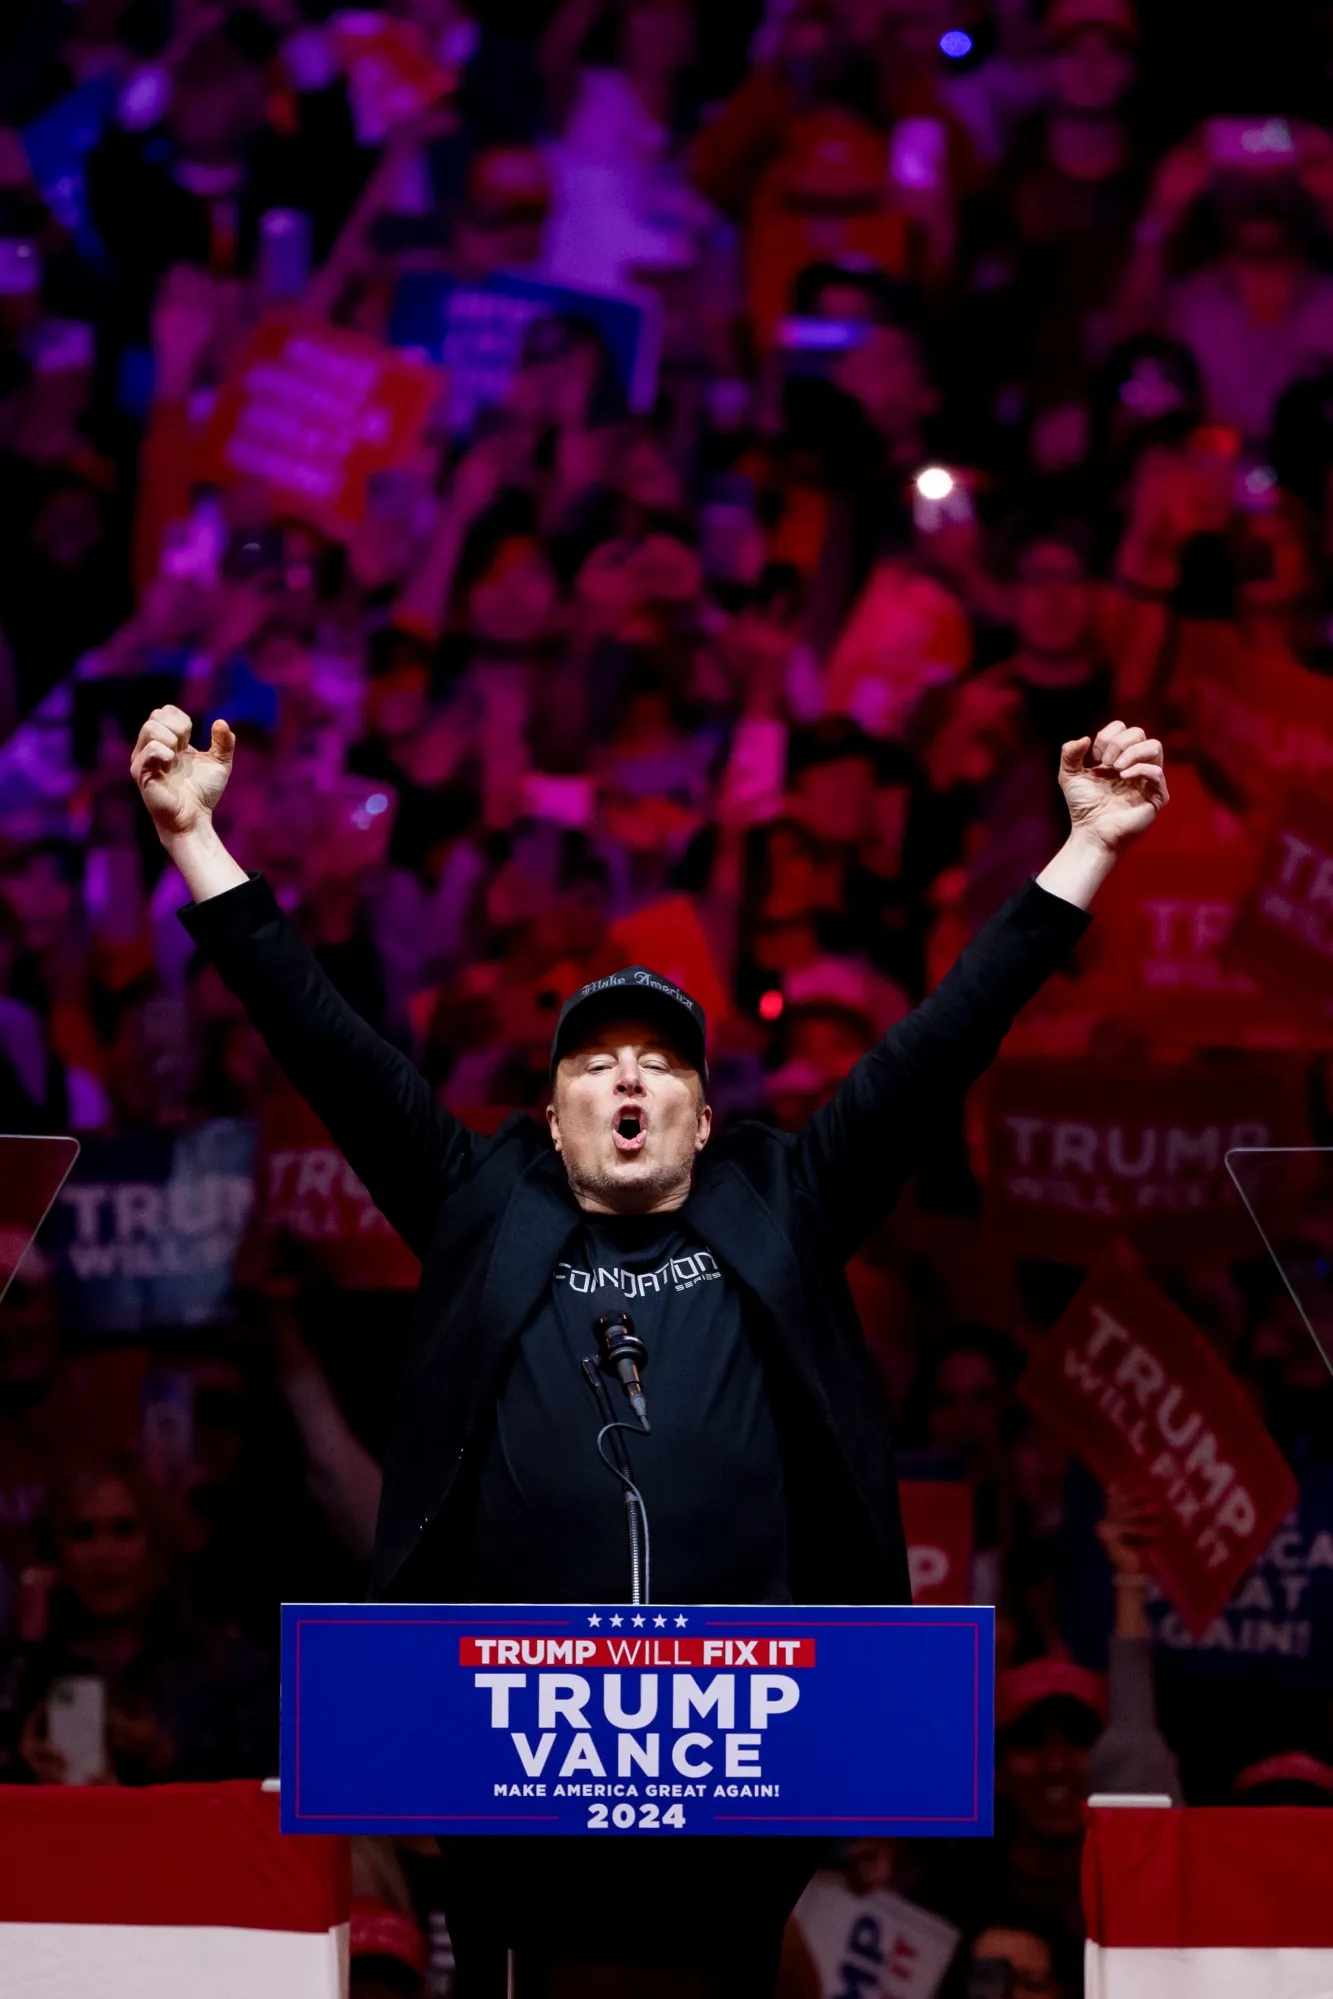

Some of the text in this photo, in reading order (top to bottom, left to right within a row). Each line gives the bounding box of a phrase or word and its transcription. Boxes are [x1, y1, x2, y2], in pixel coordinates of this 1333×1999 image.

[580, 971, 694, 1011] Make America
[1084, 1303, 1257, 1538] TRUMP
[475, 1639, 801, 1666] TRUMP WILL FIX IT
[1158, 1611, 1314, 1660] GAIN!
[474, 1673, 801, 1730] TRUMP
[510, 1732, 762, 1779] VANCE
[494, 1783, 780, 1798] MAKE AMERICA GREAT AGAIN!
[587, 1803, 686, 1829] 2024
